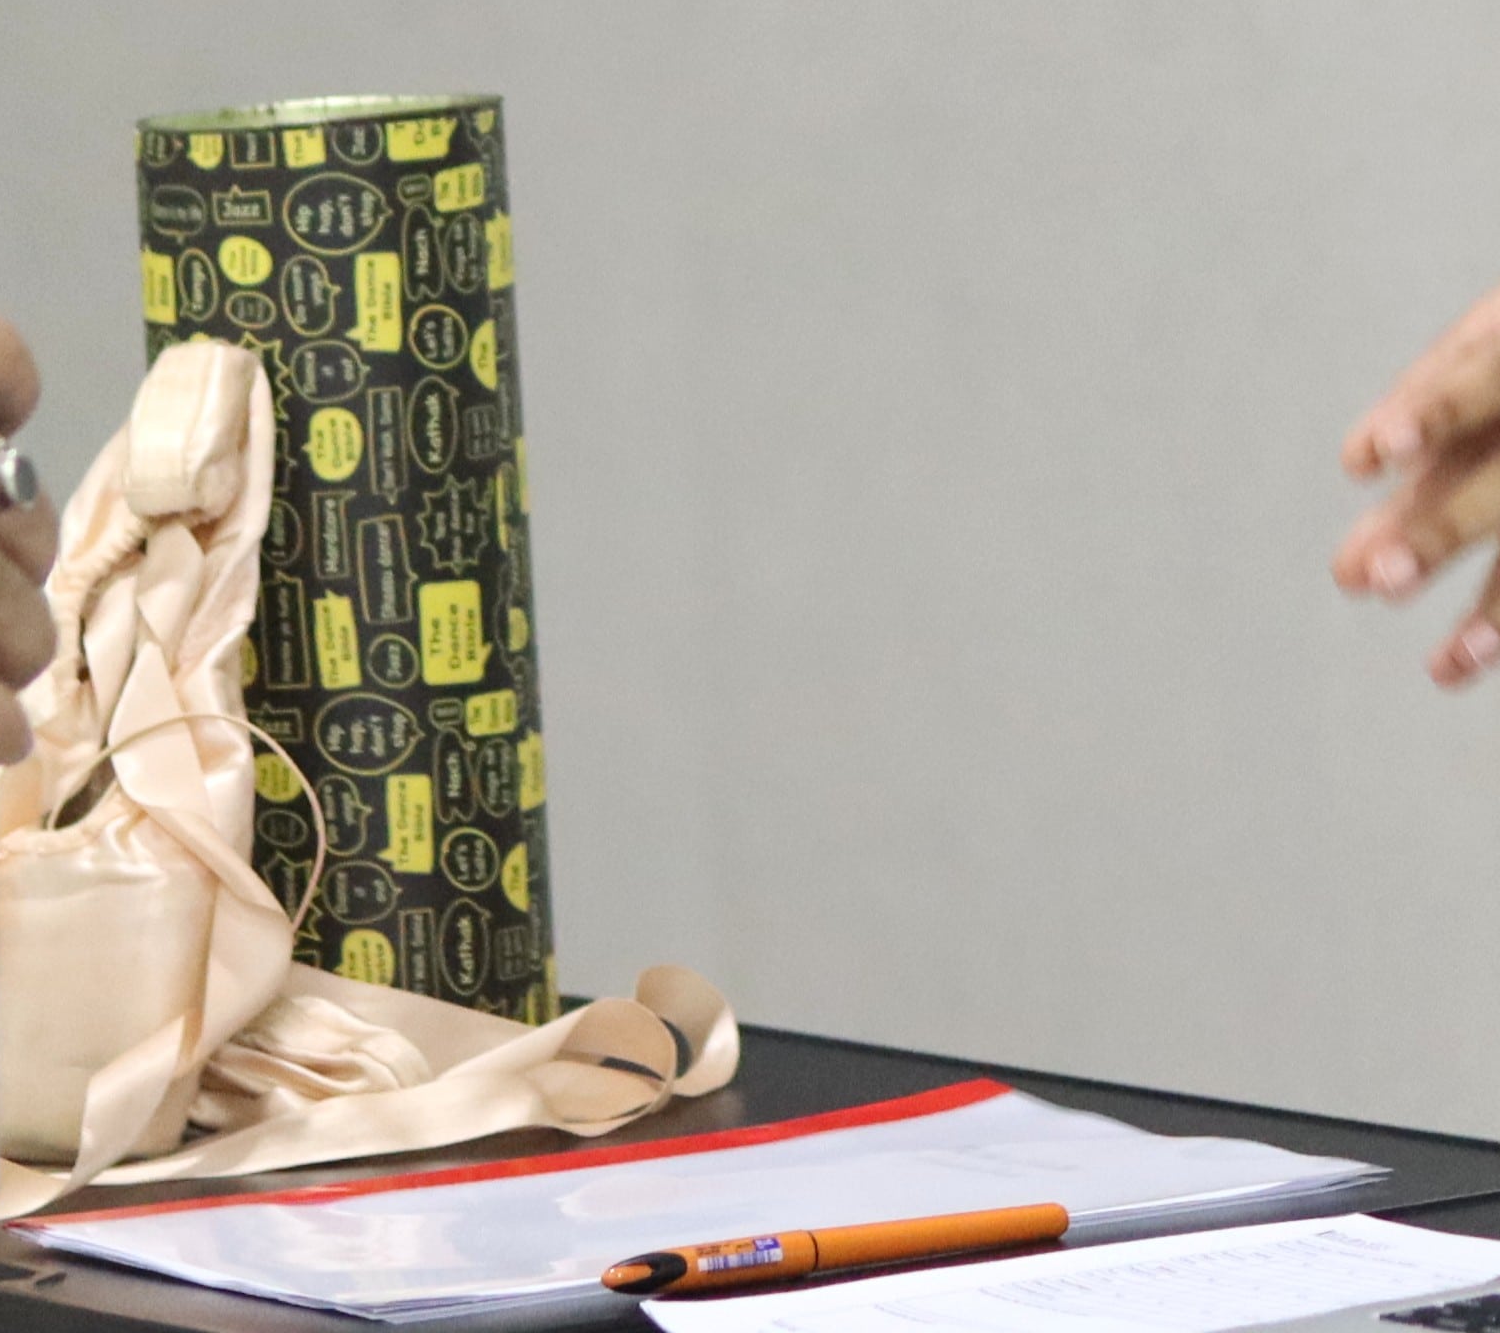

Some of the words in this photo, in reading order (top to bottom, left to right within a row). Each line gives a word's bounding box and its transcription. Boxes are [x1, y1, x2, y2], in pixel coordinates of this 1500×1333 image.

[223, 200, 262, 219] Jazz
[423, 393, 444, 464] Kathak
[386, 644, 401, 678] Jazz
[428, 616, 441, 657] The
[447, 603, 460, 670] Dance
[464, 609, 477, 662] Bible
[458, 916, 475, 986] Kathak
